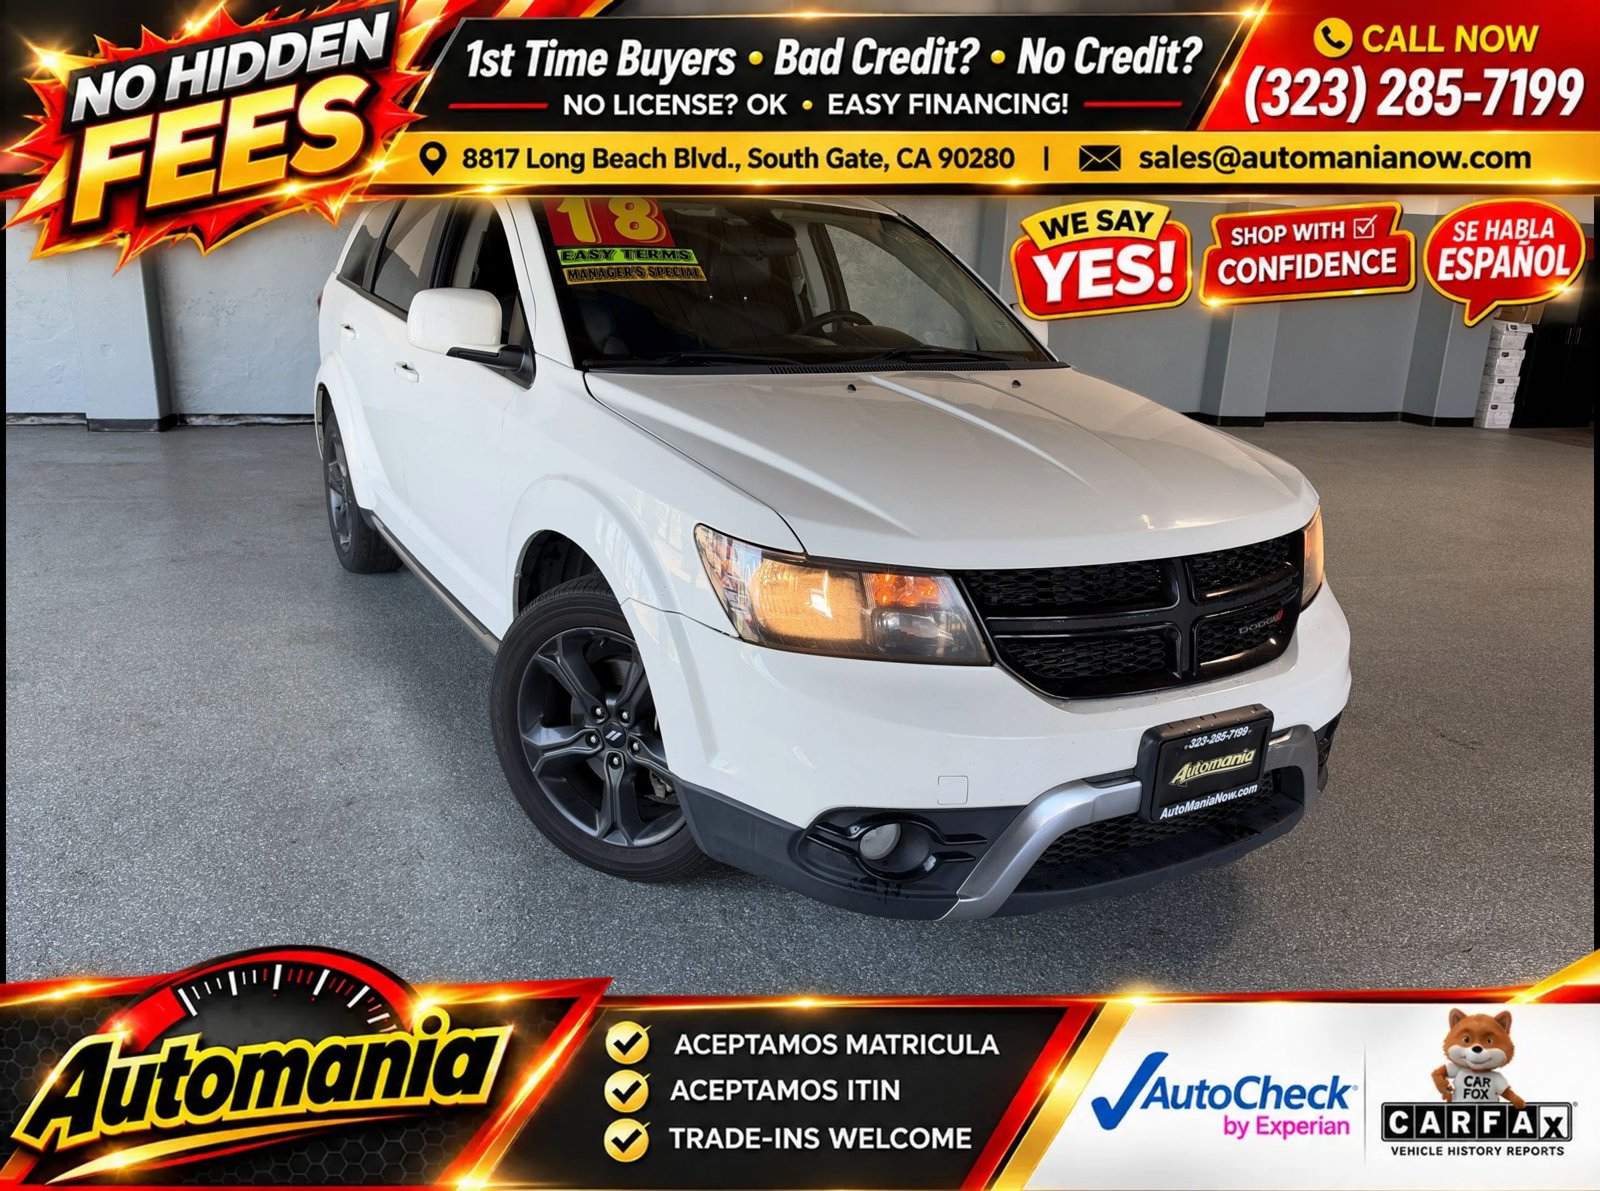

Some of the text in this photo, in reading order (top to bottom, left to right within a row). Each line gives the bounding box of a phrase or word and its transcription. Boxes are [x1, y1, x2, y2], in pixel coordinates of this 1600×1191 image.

[556, 197, 666, 243] 18
[561, 249, 693, 262] EASY TERMS
[567, 266, 702, 281] MANAGER'S SPECIAL
[1170, 748, 1257, 786] Automania
[1160, 784, 1258, 820] AutoManiaNow.com
